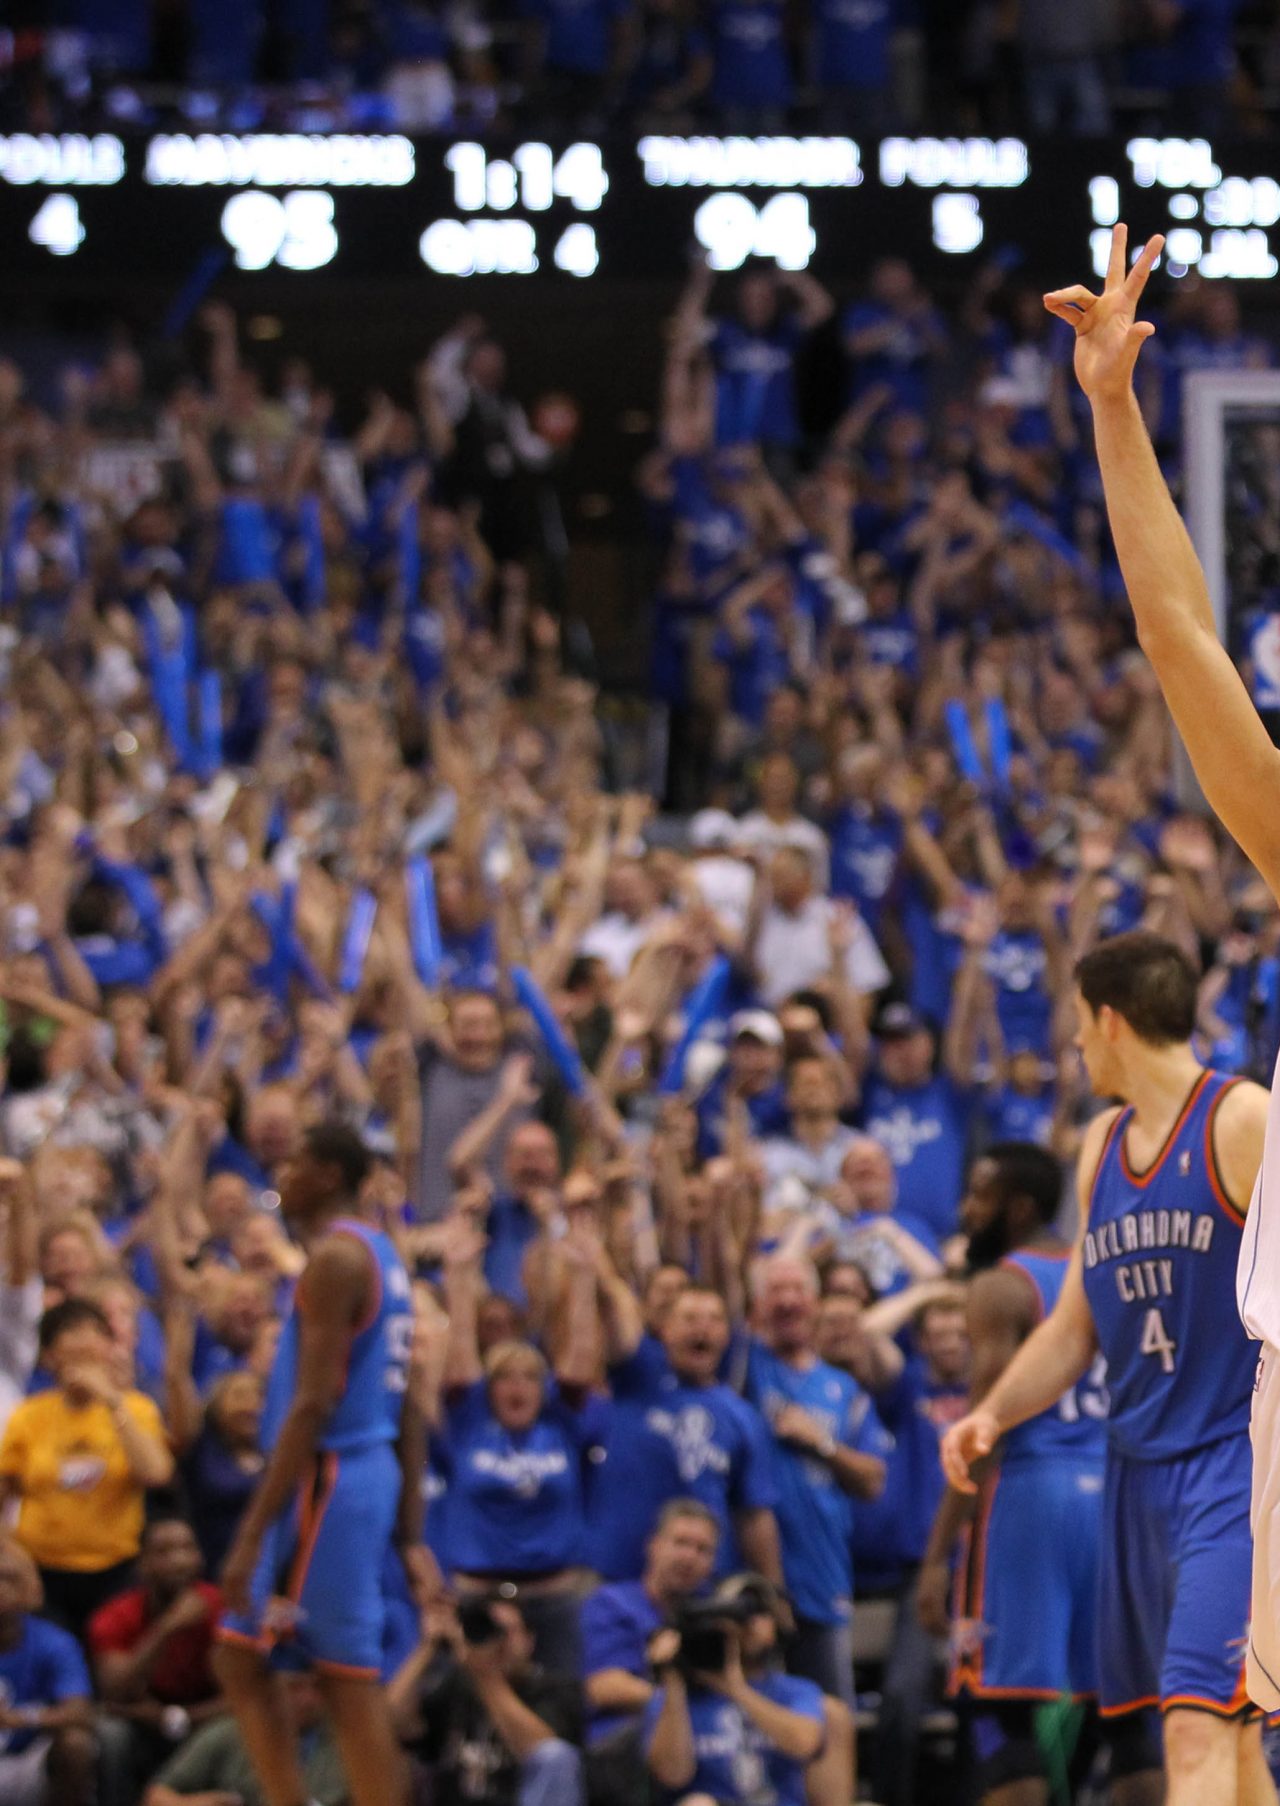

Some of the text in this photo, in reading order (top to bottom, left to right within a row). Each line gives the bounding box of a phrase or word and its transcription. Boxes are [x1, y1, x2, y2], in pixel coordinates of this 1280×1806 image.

[0, 133, 125, 186] OULS
[445, 141, 610, 212] 1:14
[29, 193, 86, 256] 4
[220, 190, 339, 271] 95
[553, 222, 600, 278] 4
[693, 191, 817, 272] 94
[1084, 1208, 1215, 1269] OKLAHOMA
[1115, 1258, 1174, 1303] CITY
[1141, 1307, 1176, 1374] 4
